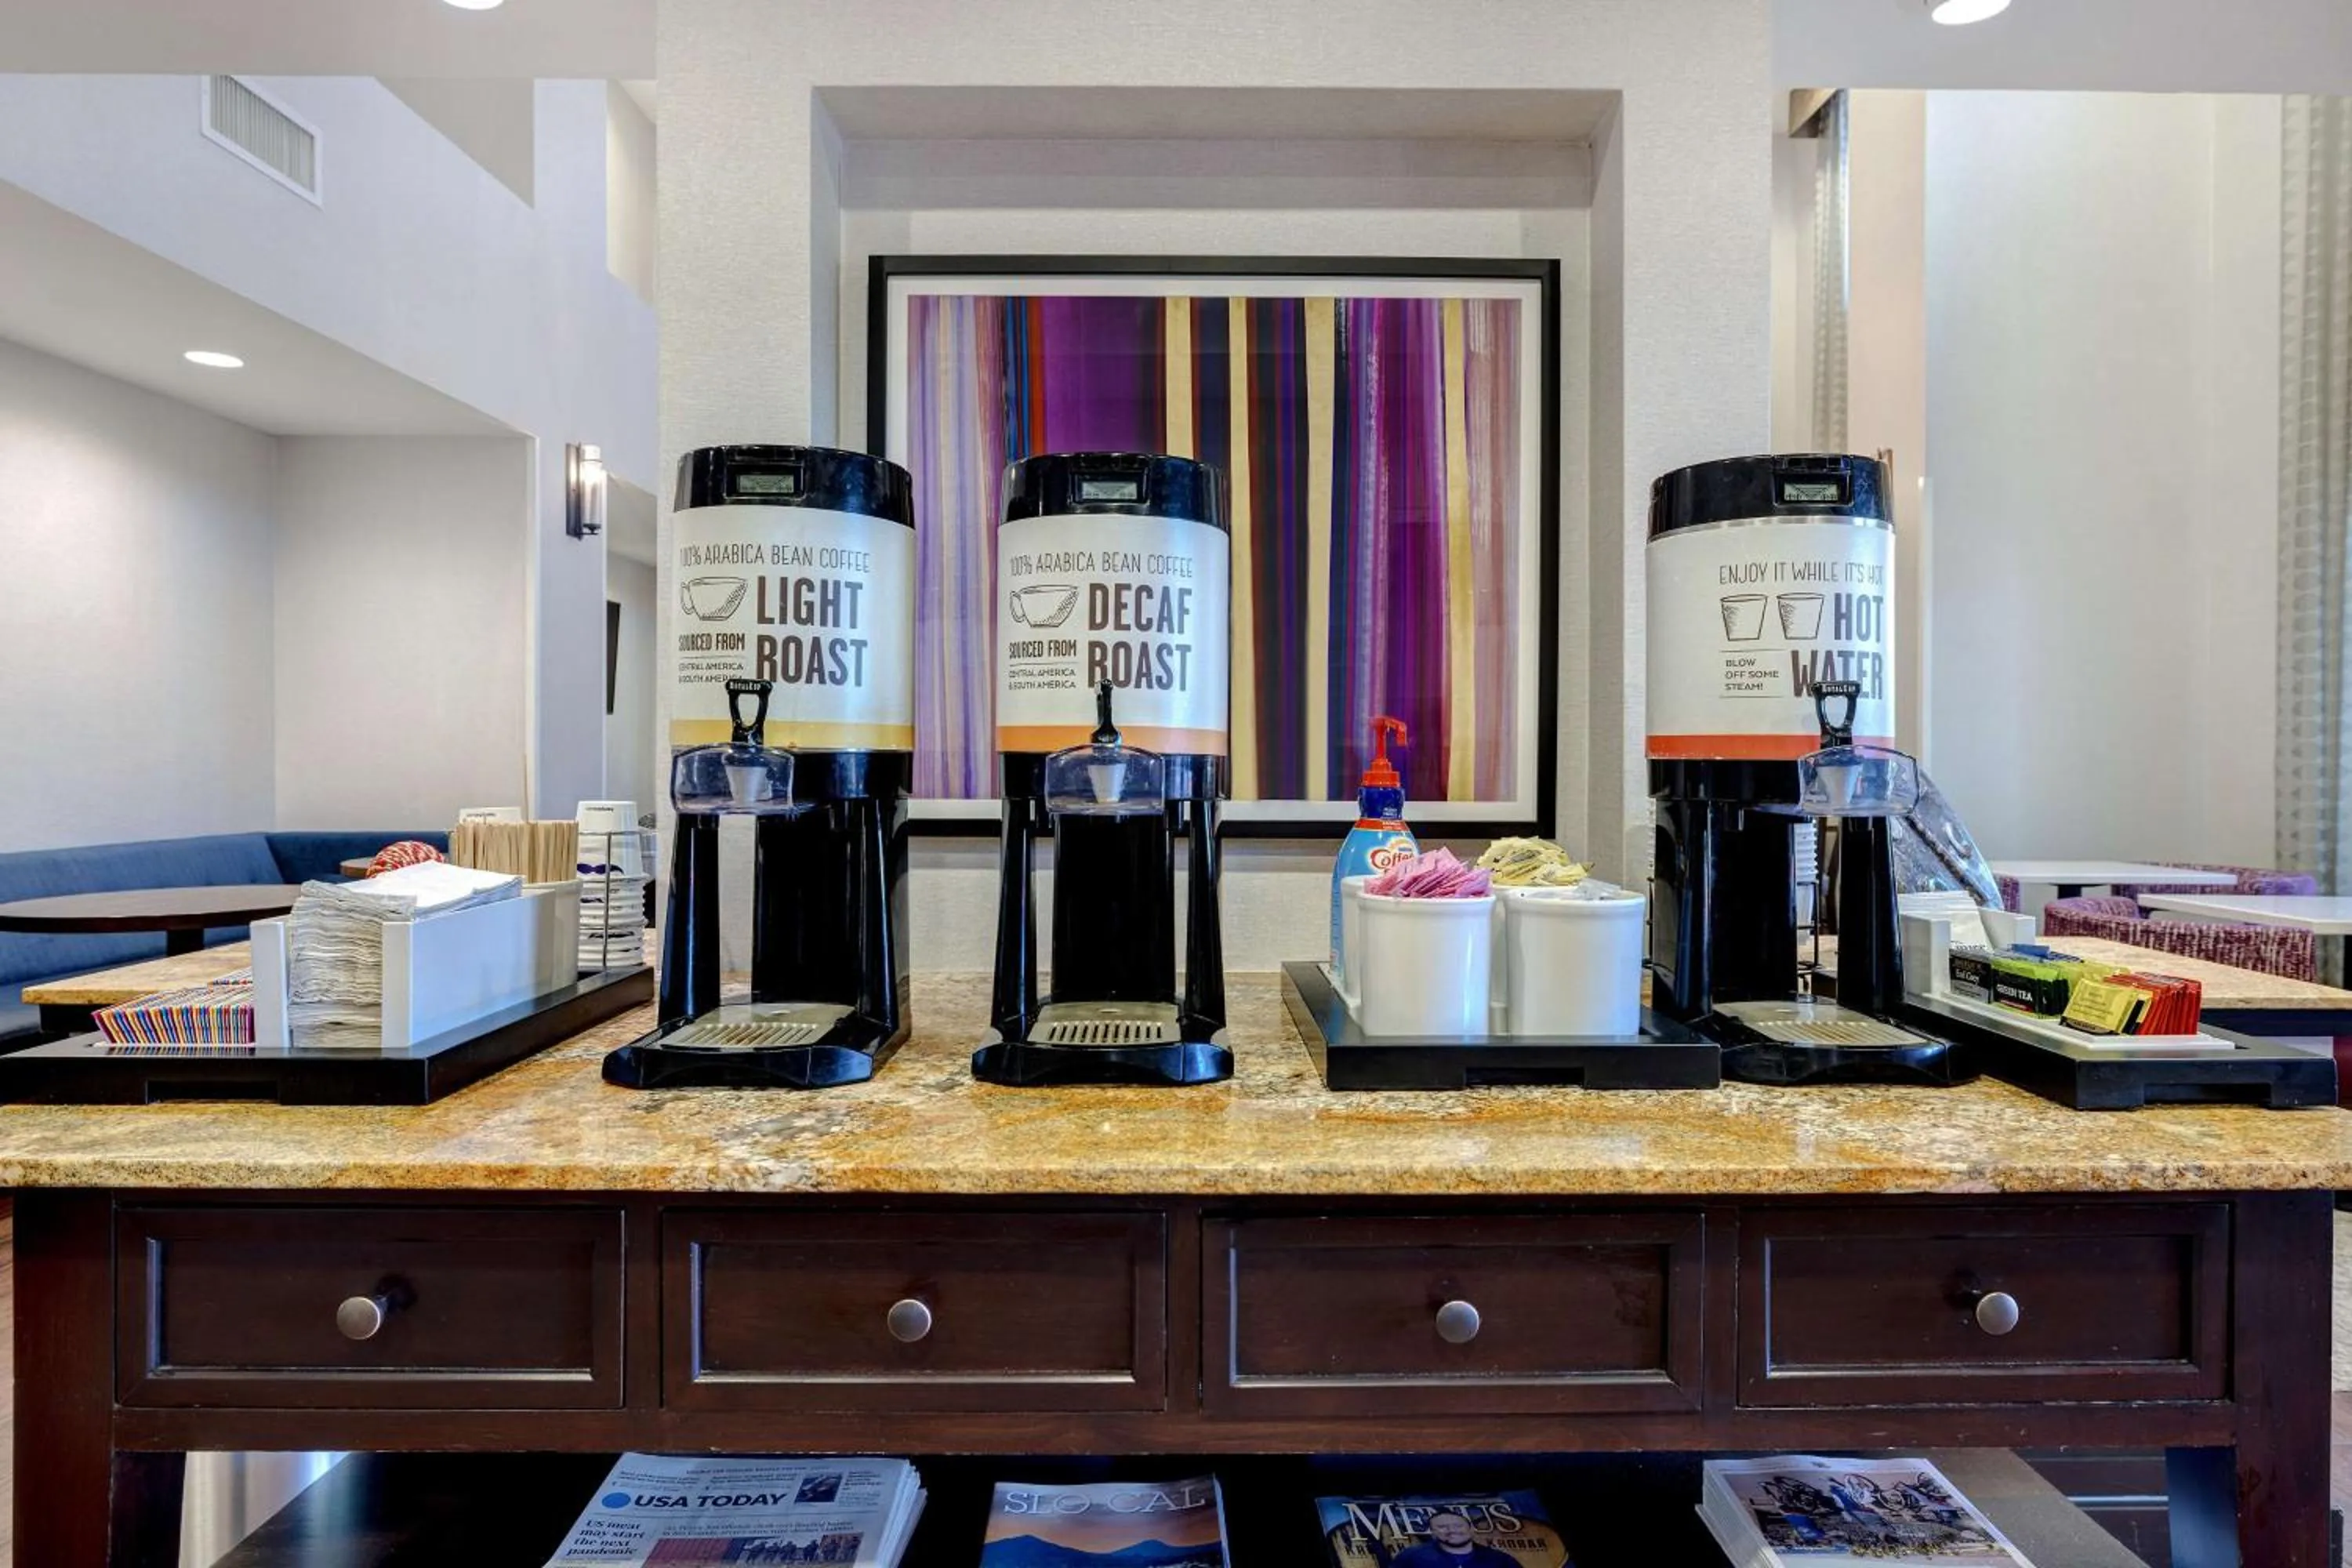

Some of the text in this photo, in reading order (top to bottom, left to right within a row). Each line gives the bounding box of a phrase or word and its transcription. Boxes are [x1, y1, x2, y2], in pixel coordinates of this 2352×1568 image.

[703, 543, 764, 565] ARABICA
[771, 545, 813, 567] BEAN
[819, 547, 871, 573] COFFEE
[1036, 552, 1095, 575] ARABICA
[1102, 551, 1141, 573] BEAN
[1148, 554, 1192, 578] COFFEE
[1719, 562, 1767, 584] ENJOY
[1774, 562, 1786, 583] IT
[1791, 561, 1838, 583] WHILE
[1845, 562, 1864, 583] IT'S
[757, 575, 863, 629] LIGHT
[1088, 583, 1192, 634] DECAF
[1834, 593, 1883, 642] HOT
[679, 633, 745, 652] SOURCED FROM
[1009, 640, 1077, 659] SOURCED FROM
[757, 634, 868, 687] ROAST
[1088, 641, 1192, 691] ROAST
[1726, 659, 1756, 667] BLOW
[1036, 680, 1076, 688] AMERICA
[1725, 671, 1745, 680] OFF
[1791, 651, 1882, 699] WATER
[2018, 989, 2033, 1001] TEA
[634, 1493, 789, 1508] USA TODAY
[1004, 1485, 1206, 1515] SLO CAL
